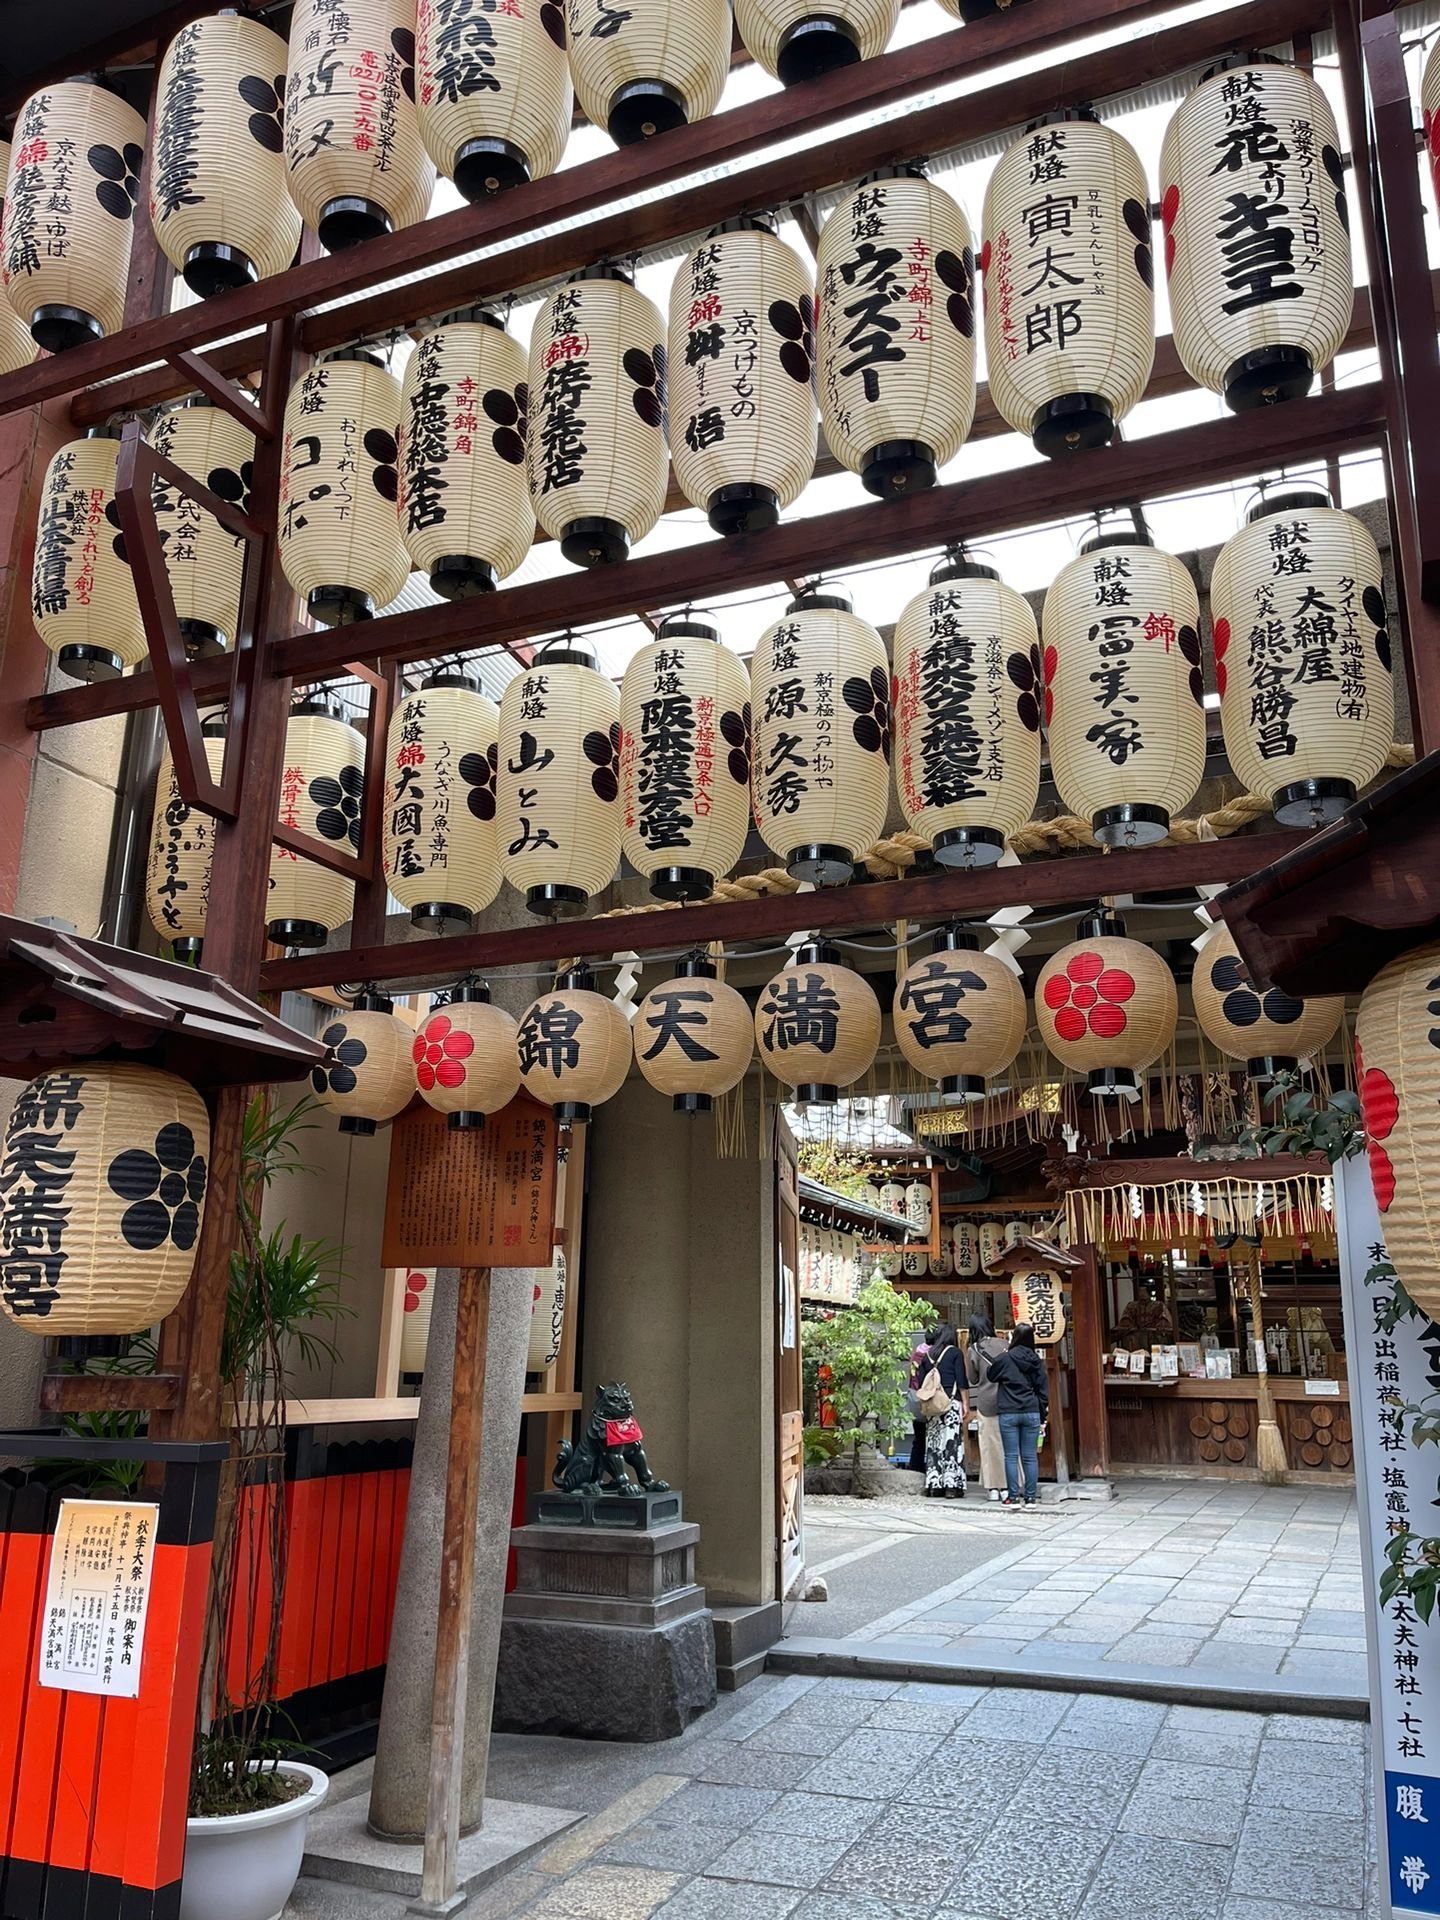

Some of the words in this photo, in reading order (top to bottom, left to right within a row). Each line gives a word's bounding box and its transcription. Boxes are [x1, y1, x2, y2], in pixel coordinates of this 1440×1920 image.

[172, 24, 204, 68] 献燈
[302, 30, 322, 52] 宿
[326, 13, 353, 46] 懐石
[22, 95, 52, 141] 献燈
[373, 53, 401, 172] 中京区御幸町四条上ル
[1220, 71, 1269, 127] 献燈
[16, 138, 48, 169] 錦
[1027, 129, 1068, 186] 献燈
[46, 138, 77, 258] 京なま麩・ゆば
[851, 187, 889, 242] 献燈
[1290, 119, 1325, 275] 湯葉クリームコロッケ
[690, 243, 723, 296] 献燈
[1020, 193, 1085, 355] 寅太郎
[1087, 189, 1106, 296] 豆乳とんしゃぶ
[550, 289, 583, 337] 献燈
[687, 293, 722, 330] 錦
[906, 238, 933, 342] 寺町錦上ル
[839, 243, 907, 403] ウィズユー
[416, 335, 445, 381] 献燈
[730, 310, 758, 420] 京つけもの
[300, 370, 329, 415] 献燈
[451, 376, 478, 454] 寺町錦角
[538, 361, 593, 495] 佐竹生花店
[49, 452, 77, 494] 献燈
[69, 489, 89, 536] 株式会社
[171, 491, 202, 562] 式会社
[74, 487, 106, 606] 日本のきれいを創る
[1268, 521, 1313, 577] 献燈
[929, 588, 963, 638] 献燈
[1092, 556, 1134, 608] 献燈
[1253, 582, 1279, 619] 代表
[772, 622, 801, 672] 献燈
[1141, 612, 1176, 654] 錦
[1291, 585, 1341, 685] 大綿屋
[519, 675, 550, 721] 献燈
[653, 648, 686, 696] 献燈
[1247, 620, 1299, 761] 熊谷勝昌
[401, 700, 427, 743] 献燈
[812, 672, 835, 789] 新京極の刃物や
[919, 636, 987, 807] 積水ハウス株式会社
[982, 635, 1007, 781] 京滋奈シャーメゾン支店
[396, 742, 426, 770] 錦
[637, 693, 697, 852] 阪本漢方堂
[693, 695, 716, 817] 新京極通四条入口
[764, 678, 809, 817] 源久秀
[391, 767, 426, 878] 大國屋
[428, 740, 455, 869] うなぎ川魚専門
[507, 731, 560, 856] 山とみ
[517, 1000, 584, 1079] 錦
[641, 990, 721, 1062] 天
[762, 973, 841, 1054] 満
[900, 961, 989, 1050] 宮
[530, 1118, 547, 1181] 錦天満宮
[0, 1073, 88, 1317] 錦天満宮
[1023, 1271, 1057, 1339] 錦天満宮
[130, 1519, 150, 1582] 秋季大祭
[110, 1555, 124, 1620] 十一月二十五日
[120, 1617, 137, 1666] 御案内
